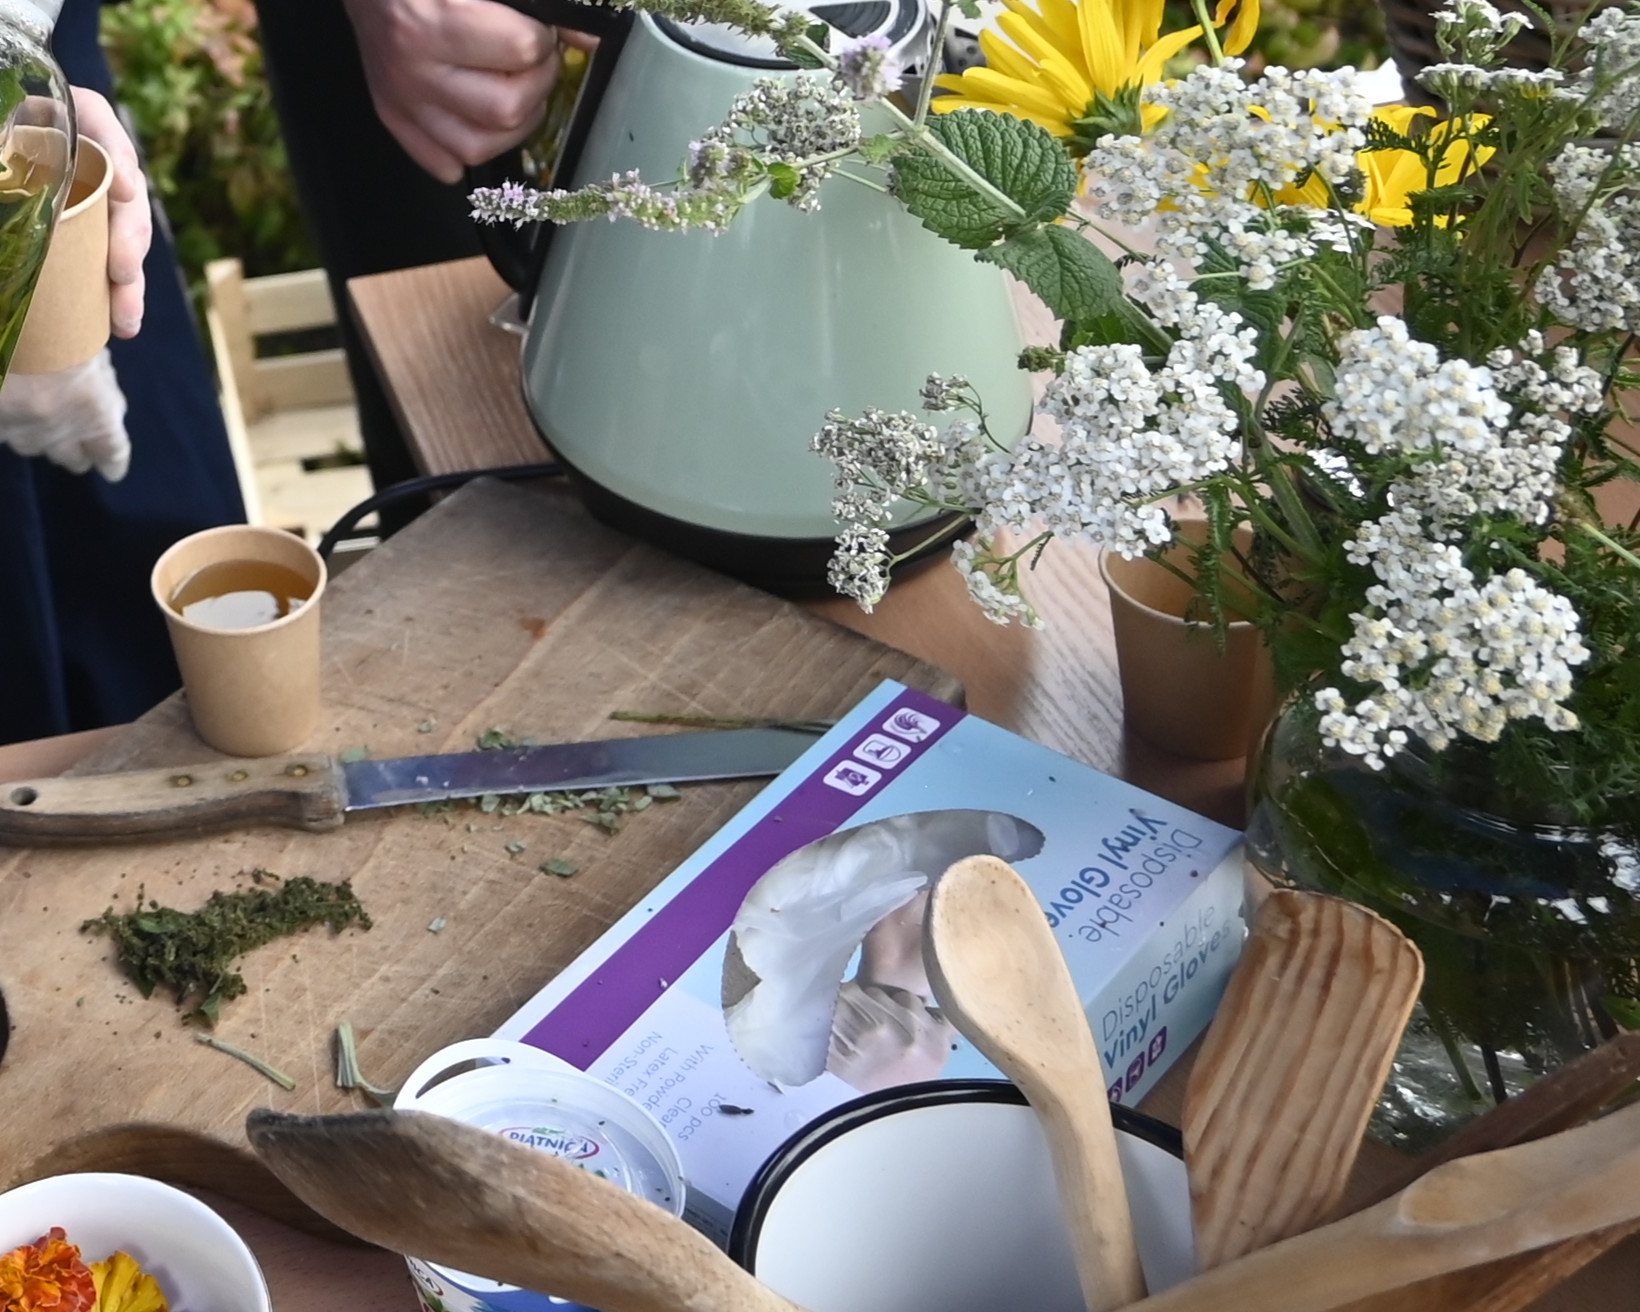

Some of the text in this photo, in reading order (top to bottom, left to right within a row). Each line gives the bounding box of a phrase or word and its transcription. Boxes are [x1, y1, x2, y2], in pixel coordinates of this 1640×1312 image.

[1044, 814, 1168, 929] Vinyl Glove
[1078, 828, 1203, 943] Disposable
[1102, 905, 1215, 1042] Disposable
[1104, 919, 1233, 1070] Vinyl Gloves
[603, 1030, 663, 1087] Non-Steril
[623, 1047, 678, 1097] Latex Fre
[641, 1044, 714, 1111] With Powde
[677, 1092, 727, 1141] 100 pcs
